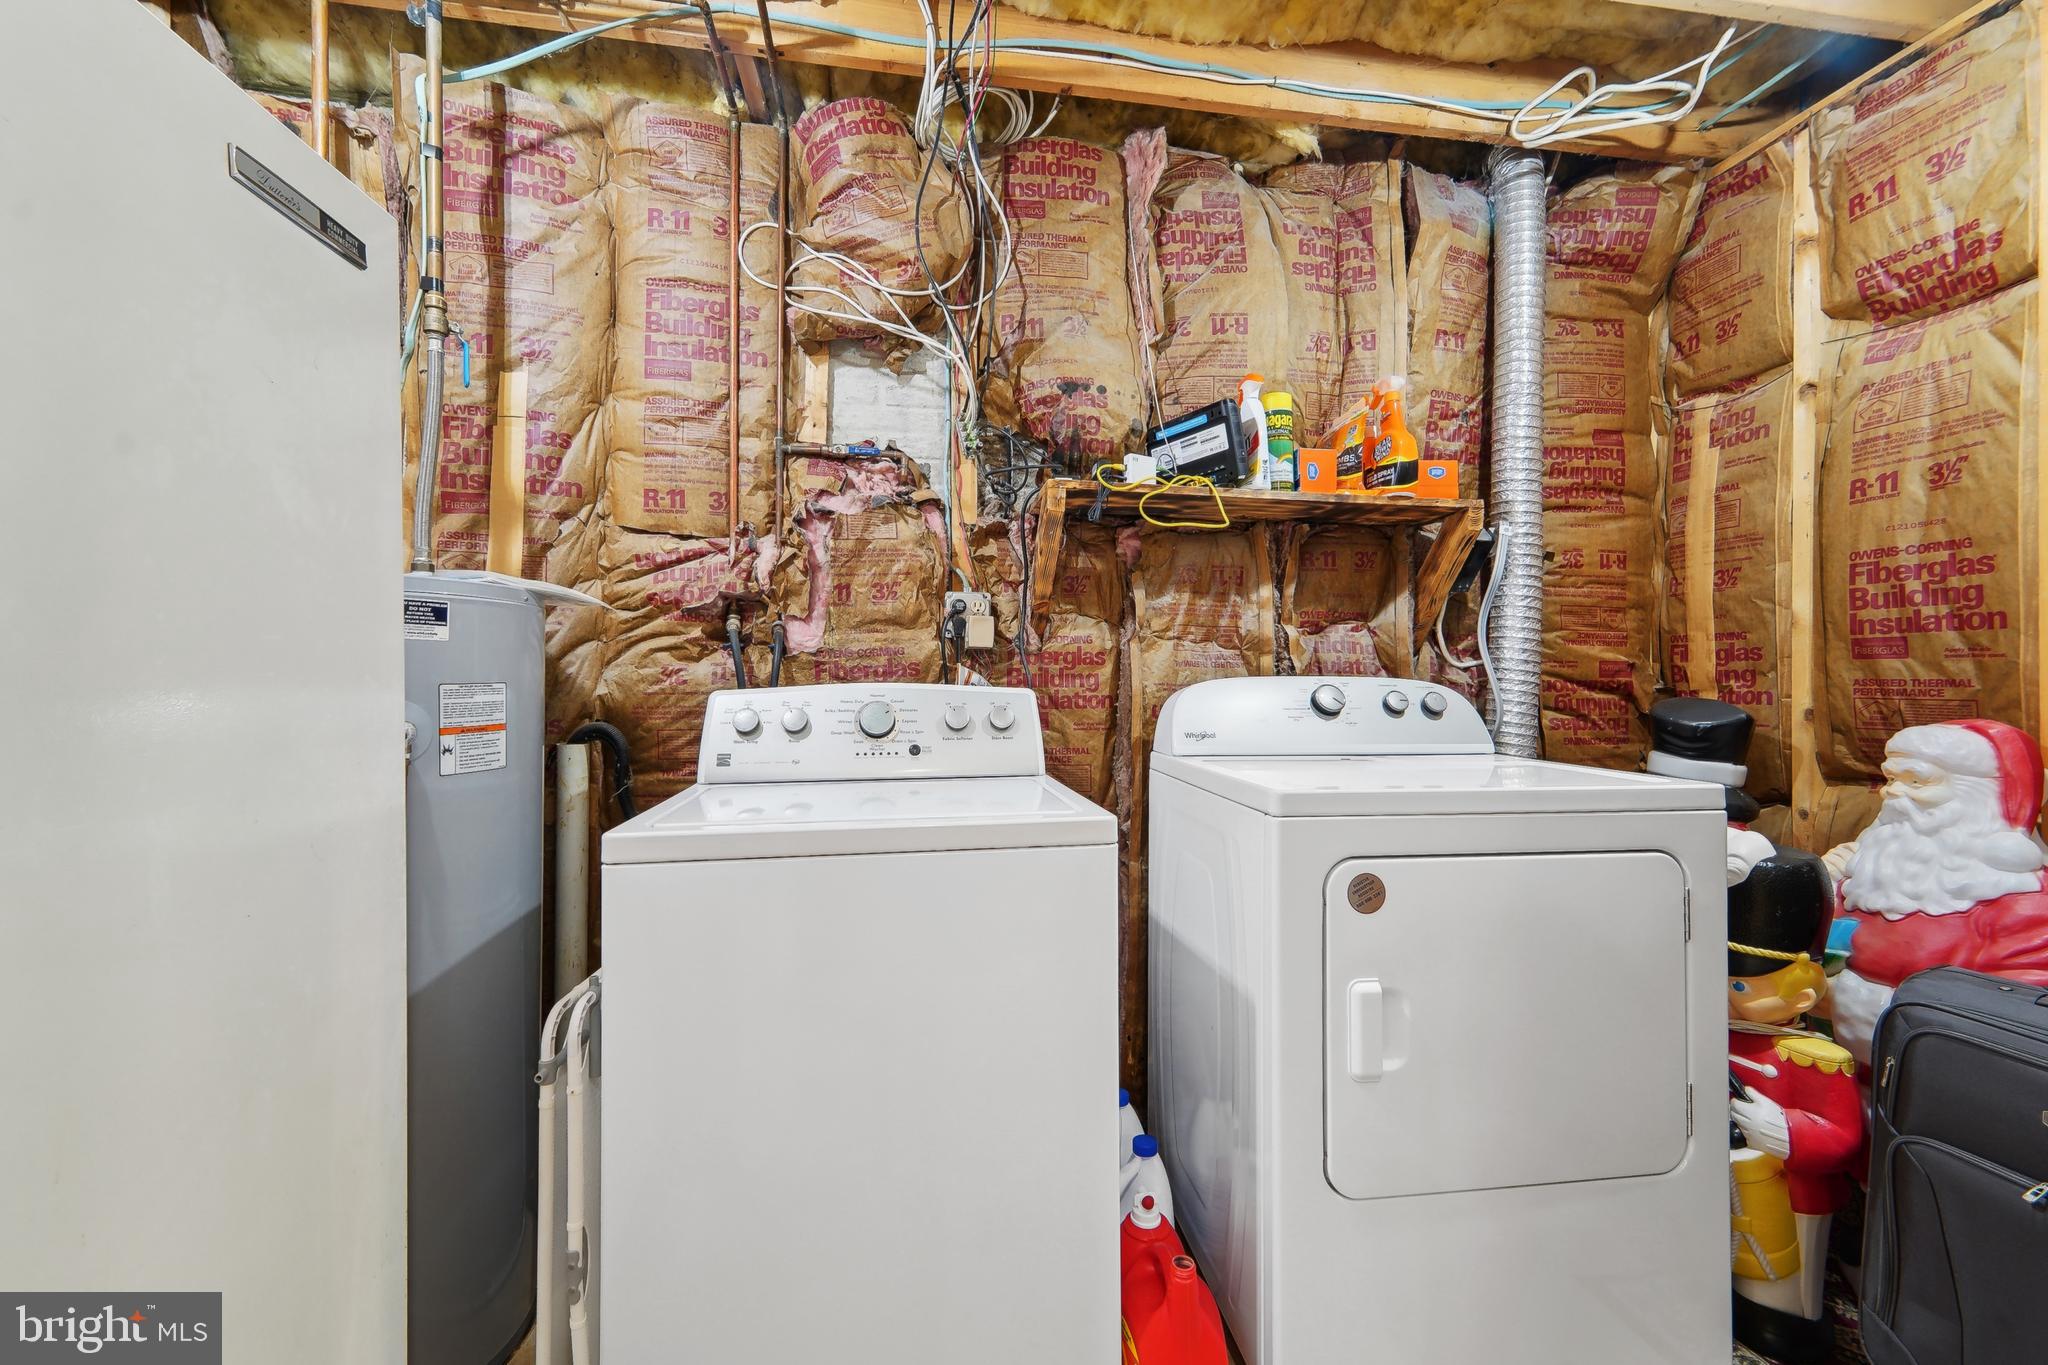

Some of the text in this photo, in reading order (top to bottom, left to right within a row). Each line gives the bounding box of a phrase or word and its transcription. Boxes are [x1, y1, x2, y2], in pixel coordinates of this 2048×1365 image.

[1908, 39, 1968, 81] THERMAL
[645, 115, 730, 137] ASSURED THERM
[794, 97, 887, 146] Building
[645, 126, 721, 143] PERFORMANCE
[805, 117, 907, 166] Insulation
[444, 139, 566, 189] Building
[1004, 154, 1097, 187] Building
[1004, 175, 1110, 207] Insulation
[1849, 174, 1898, 218] R-11
[647, 207, 691, 231] R-11
[444, 231, 555, 255] ASSURED THERMAL
[1045, 232, 1088, 244] THERMAL
[1703, 229, 1742, 254] THERMAL
[1855, 218, 1981, 279] OWENS-CORNING
[444, 241, 529, 260] PERFORMANCE
[1856, 230, 2004, 301] Fiberglas
[1554, 270, 1632, 284] OWENS-CORNING
[1866, 262, 1999, 323] Building
[645, 288, 761, 322] Fibergas
[1210, 317, 1248, 336] R-11
[1434, 328, 1466, 350] R-11
[644, 335, 769, 368] Insulaton
[647, 367, 690, 378] FIBERGLAS
[1915, 351, 1973, 376] THERMAL
[644, 397, 730, 410] ASSURED THERM
[644, 405, 718, 419] PERFORMANCE
[1558, 406, 1626, 415] ASSURED THERMAL
[1575, 400, 1626, 408] PERFORMANCE
[1549, 462, 1626, 487] Building
[1849, 470, 1900, 500] R-11
[643, 488, 686, 509] R-11
[1849, 491, 1900, 505] INSULATION ONLY
[1300, 550, 1337, 569] R-11
[1849, 536, 1974, 562] OWENS-CORNING
[1599, 553, 1628, 571] R-11
[1849, 552, 1997, 586] Fiberglas
[1849, 583, 1985, 611] Building
[1849, 607, 2008, 636] Insulation
[1854, 646, 1905, 656] FIBERGLAS
[813, 659, 921, 681] Fiberglas
[1210, 660, 1241, 668] SSURED
[1853, 679, 1975, 688] ASSURED THERMAL
[1853, 688, 1945, 698] PERFORMANCE
[1184, 732, 1216, 742] Whirlpool
[1551, 716, 1630, 738] Fiberglas
[1051, 747, 1092, 755] THERMAL
